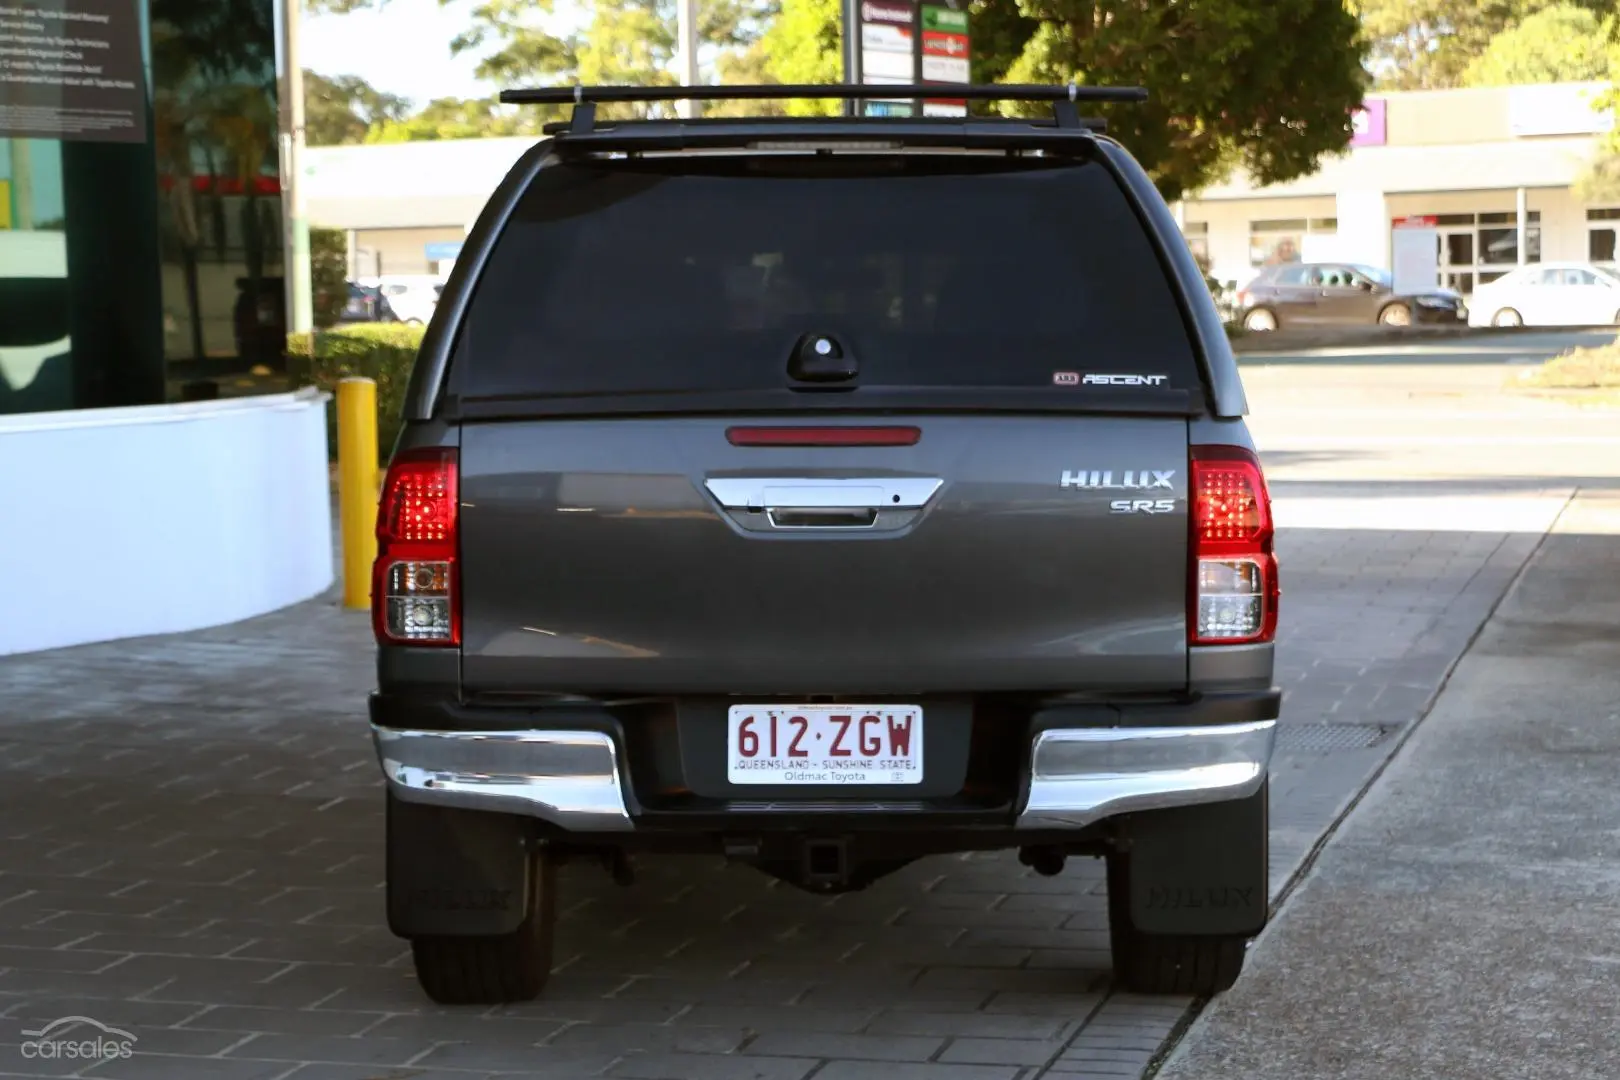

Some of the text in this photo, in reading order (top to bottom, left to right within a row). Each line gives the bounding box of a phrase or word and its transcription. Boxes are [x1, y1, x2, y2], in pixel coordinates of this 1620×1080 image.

[1082, 374, 1168, 386] ASCENT
[1060, 469, 1176, 490] HILUX
[1110, 499, 1175, 514] SR5
[738, 759, 810, 770] QUEENSLAND
[822, 759, 873, 770] SUNSHINE
[879, 759, 912, 770] STATE
[784, 771, 867, 784] Oldmac Toyota
[1145, 886, 1253, 909] HILUX
